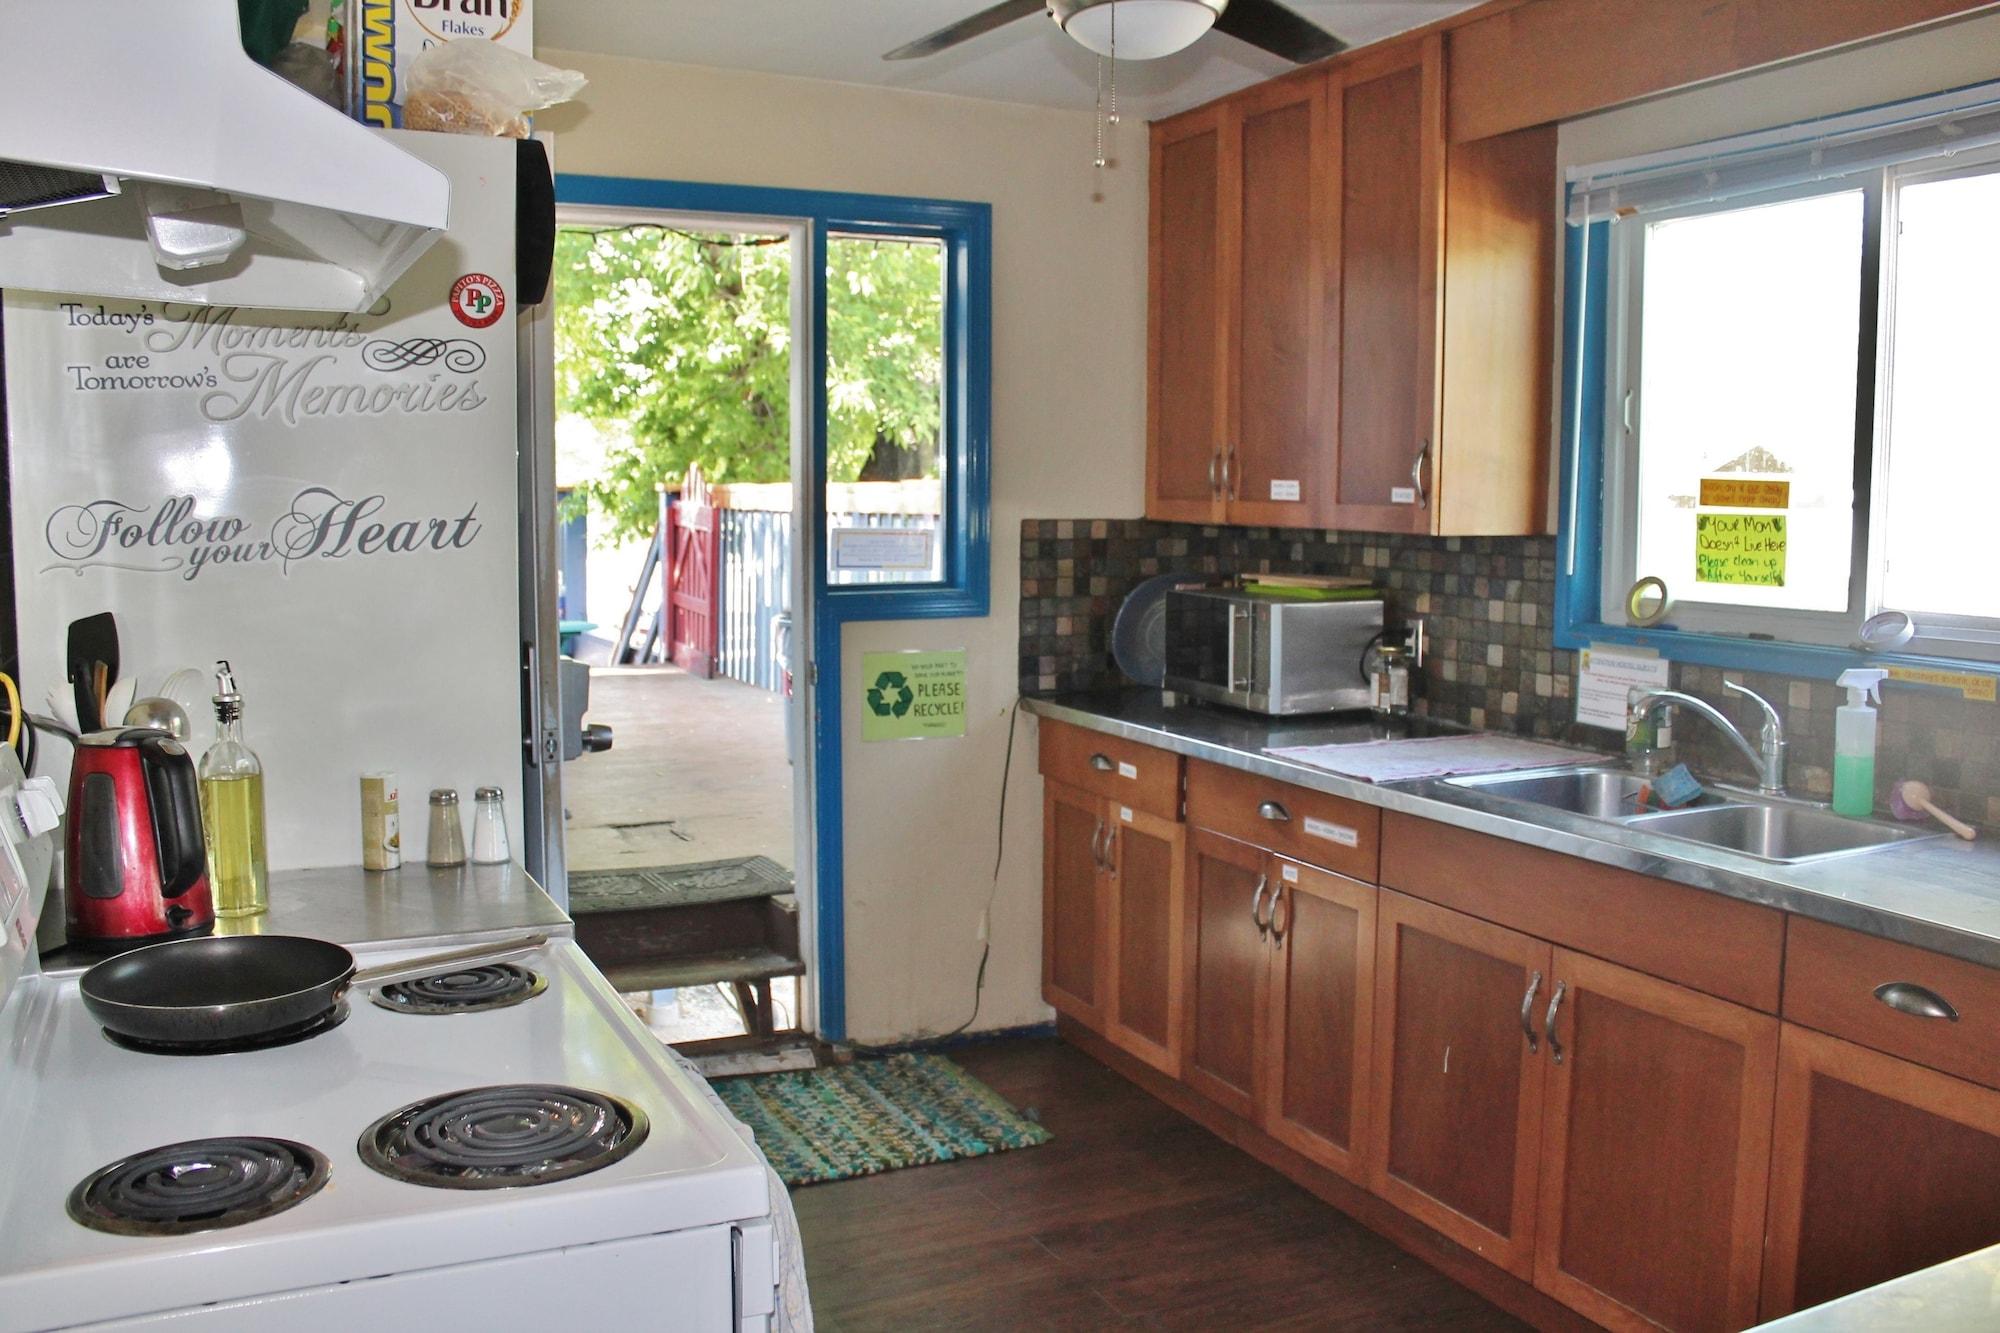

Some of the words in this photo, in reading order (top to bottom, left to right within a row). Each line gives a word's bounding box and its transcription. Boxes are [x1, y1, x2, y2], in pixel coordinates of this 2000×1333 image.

[413, 0, 507, 18] an
[441, 20, 485, 36] Flakes
[364, 0, 394, 128] JUM
[61, 303, 155, 334] Today's
[144, 301, 368, 356] Moments
[104, 352, 151, 370] are
[67, 366, 218, 391] Tomorrow's
[201, 351, 488, 425] Memories
[46, 496, 252, 561] Follow
[182, 539, 277, 581] your
[271, 487, 483, 576] Heart
[1744, 517, 1772, 534] Mom
[918, 682, 961, 697] PLEASE
[914, 701, 965, 717] RECYCLE!
